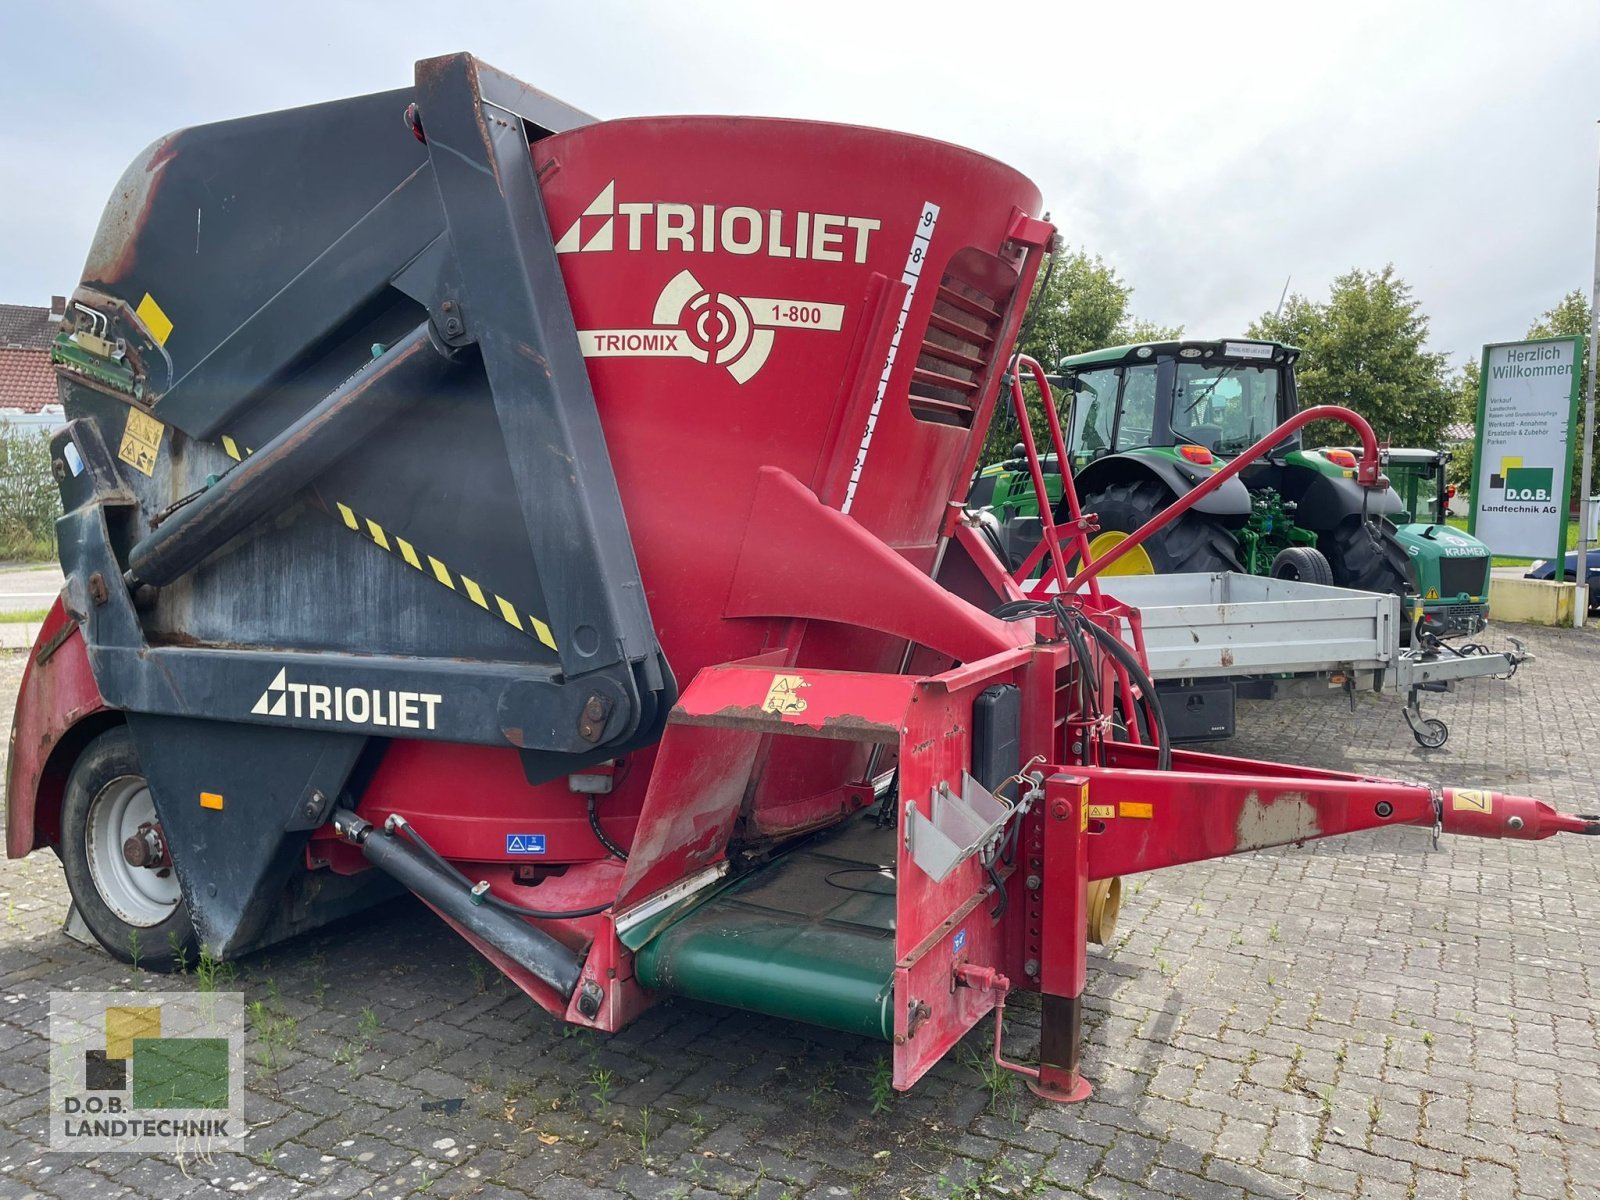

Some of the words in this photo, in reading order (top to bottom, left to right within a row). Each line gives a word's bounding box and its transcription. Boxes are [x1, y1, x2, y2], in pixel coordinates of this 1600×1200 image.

[923, 211, 934, 227] 9
[618, 202, 882, 264] TRIOLIET
[912, 247, 923, 263] 8
[771, 304, 822, 325] 1-800
[594, 334, 679, 352] TRIOMIX
[1507, 345, 1560, 363] Herzlich
[1493, 363, 1573, 379] Willkommen
[1490, 396, 1512, 404] Verkauf
[1506, 488, 1551, 500] D.O.B.
[1481, 504, 1540, 514] Landtechnik
[1542, 506, 1557, 514] AG
[1444, 547, 1487, 557] KRAMER
[288, 682, 442, 730] TRIOLIET
